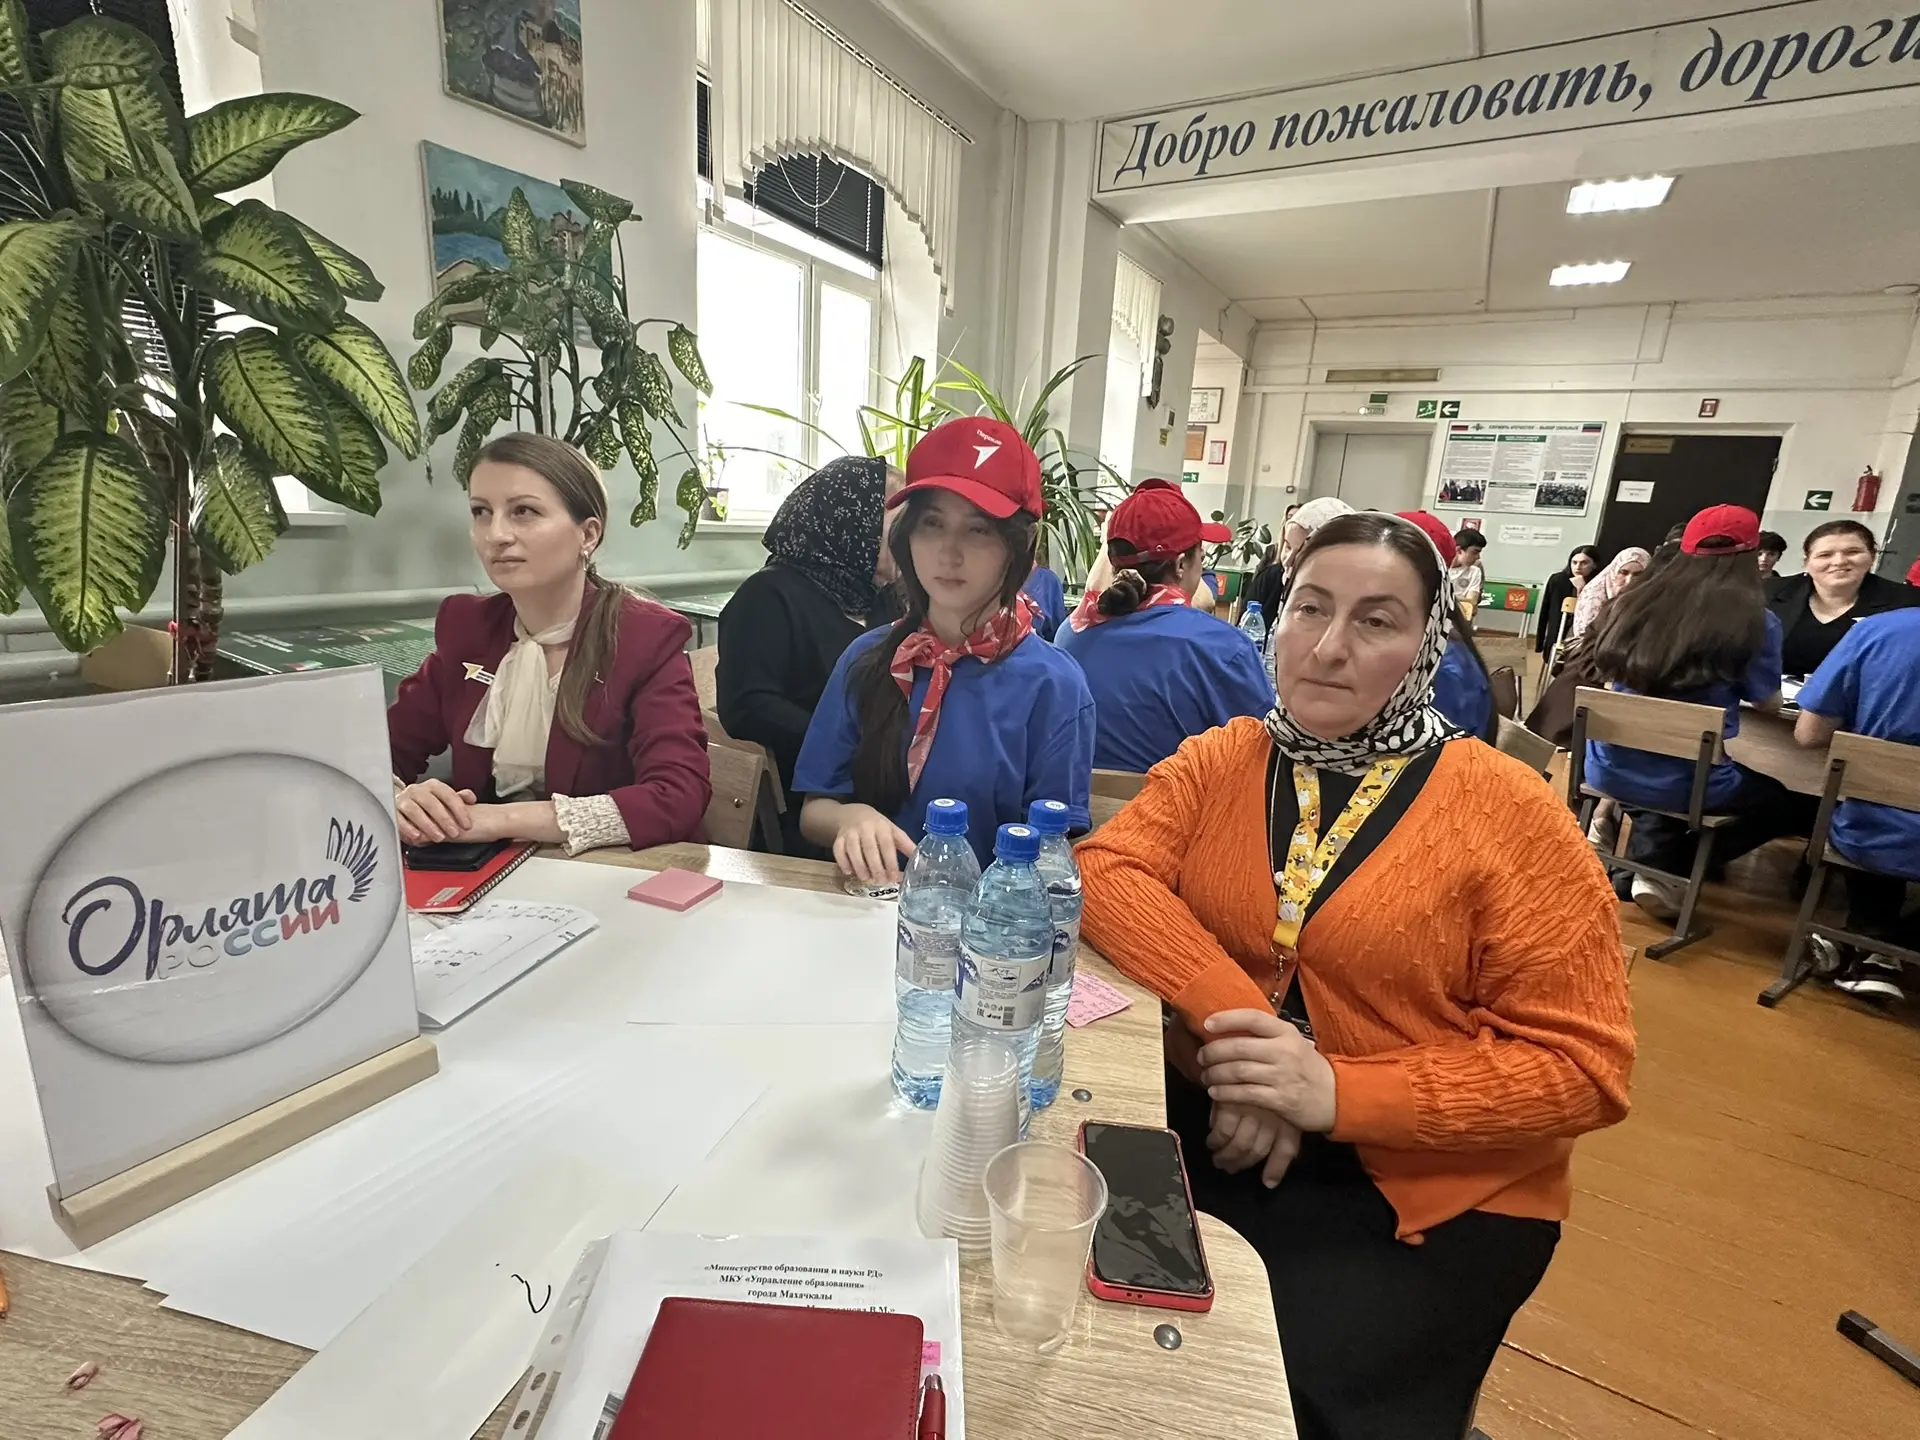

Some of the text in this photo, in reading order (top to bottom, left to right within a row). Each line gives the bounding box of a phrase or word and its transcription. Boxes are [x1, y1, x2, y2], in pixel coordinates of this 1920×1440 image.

[1113, 112, 1257, 184] Добро
[1268, 60, 1654, 152] пожаловать,
[62, 874, 337, 981] Орлята
[704, 1263, 773, 1273] «Министерство
[774, 1264, 830, 1275] образования
[838, 1268, 865, 1277] науки
[866, 1269, 883, 1279] РД»
[719, 1274, 865, 1289] МКУ «Управление образования»
[747, 1289, 833, 1301] города Махачкалы
